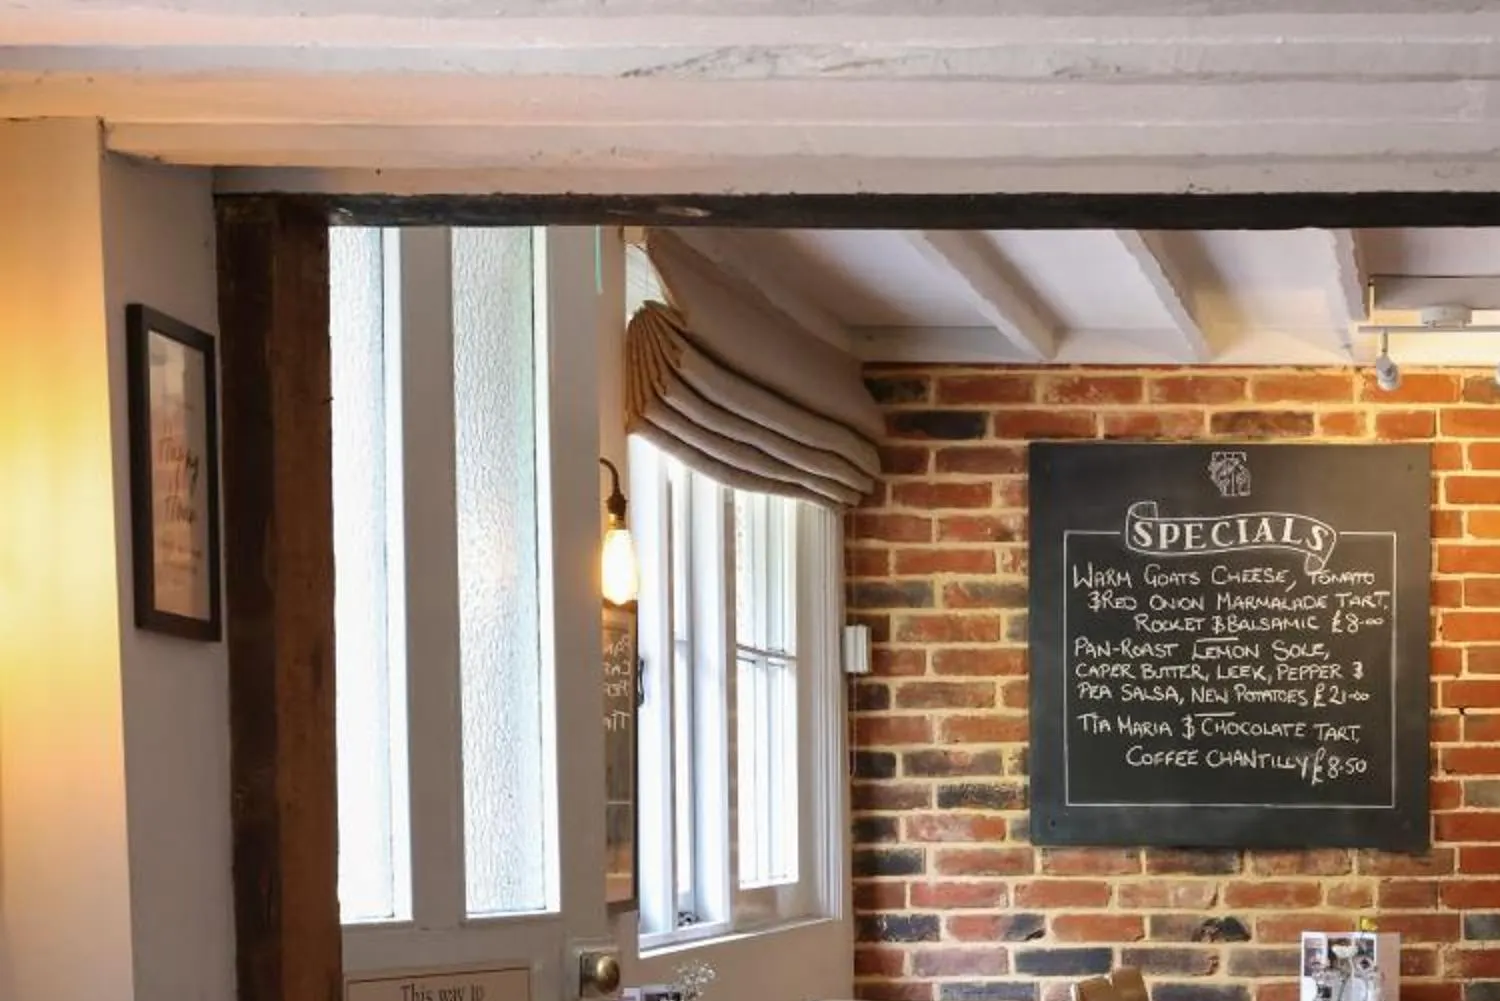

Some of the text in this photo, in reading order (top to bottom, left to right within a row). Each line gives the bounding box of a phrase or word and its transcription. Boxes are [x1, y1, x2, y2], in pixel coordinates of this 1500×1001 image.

[1132, 517, 1329, 552] SPECIALS
[1073, 561, 1376, 593] WARM GOATS CHEESE, TOMATO
[1150, 594, 1205, 612] ONION
[1217, 591, 1328, 612] MARMALADE
[1133, 613, 1206, 633] ROCKET
[1074, 636, 1330, 661] PAN-ROAST LEMON SOLE,
[1075, 663, 1136, 680] CAPER
[1140, 663, 1209, 683] BUTTER,
[1217, 664, 1273, 685] LEEK,
[1277, 663, 1344, 681] PEPPER
[1076, 681, 1113, 699] PEA
[1121, 684, 1185, 705] SALSA,
[1191, 685, 1228, 704] NEW
[1233, 683, 1309, 707] POTATOES
[1076, 711, 1111, 735] TIA
[1117, 714, 1173, 739] MARIA
[1201, 717, 1307, 738] CHOCOLATE
[1126, 745, 1199, 767] COFFEE
[1205, 748, 1308, 779] CHANTILLY
